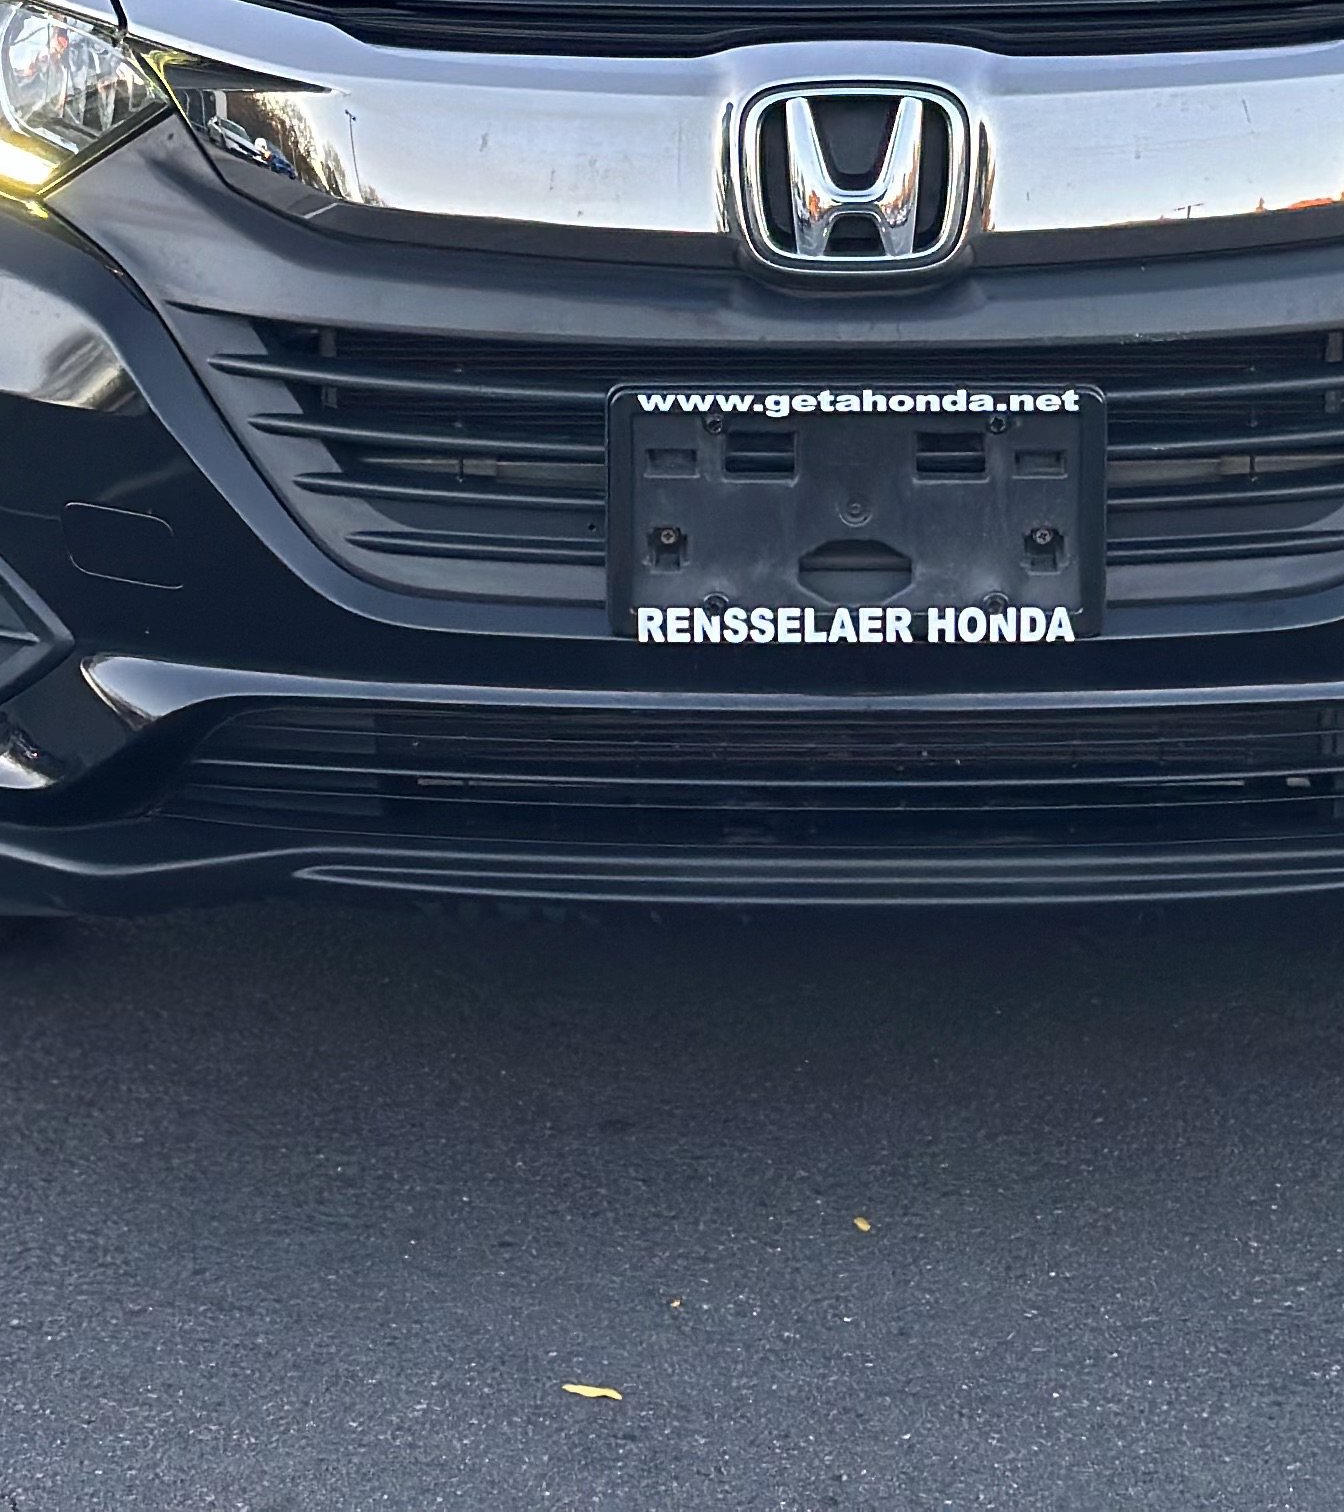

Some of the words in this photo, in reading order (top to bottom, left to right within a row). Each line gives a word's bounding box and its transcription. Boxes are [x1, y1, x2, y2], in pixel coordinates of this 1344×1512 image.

[637, 389, 1080, 418] www.getahonda.net
[637, 607, 914, 644] RENSSELAER
[927, 606, 1076, 644] HONDA
